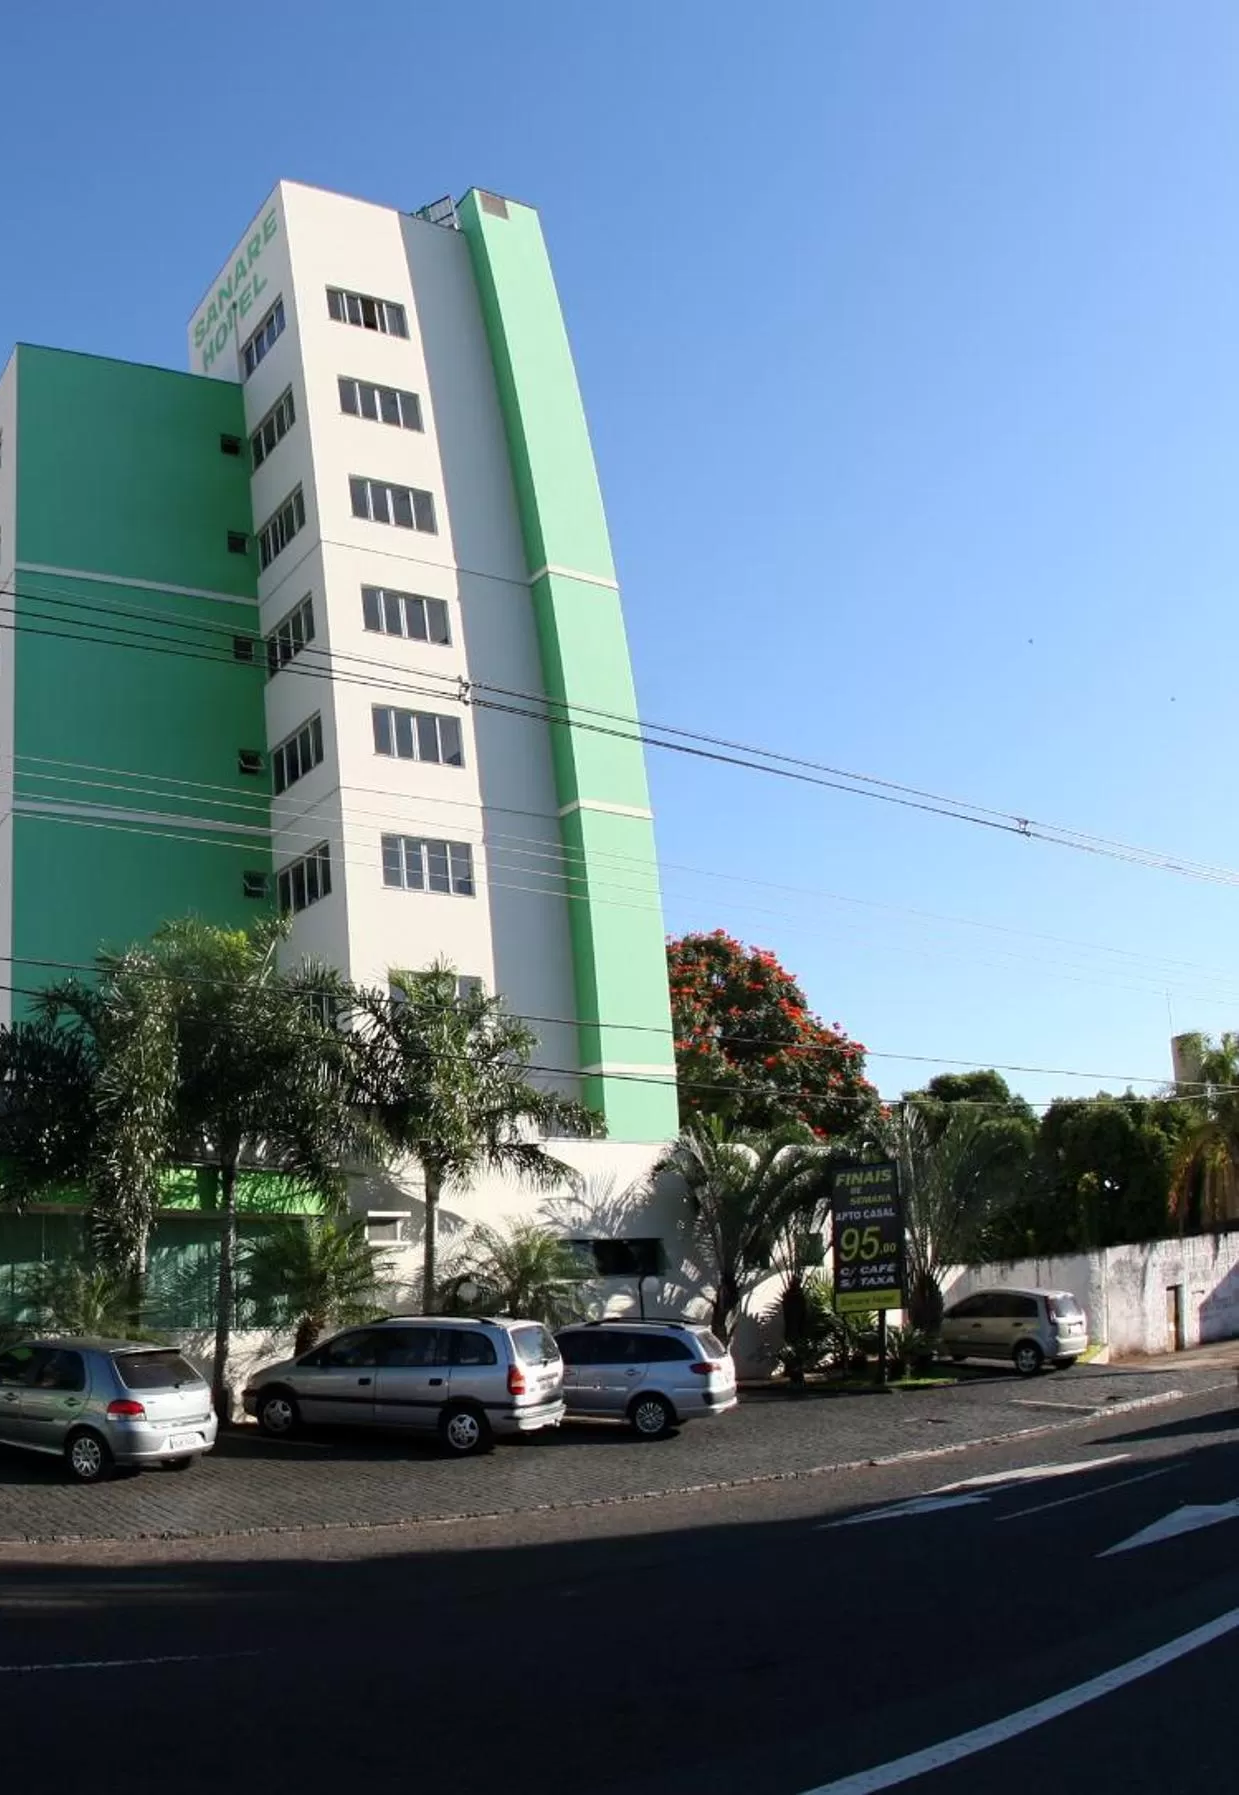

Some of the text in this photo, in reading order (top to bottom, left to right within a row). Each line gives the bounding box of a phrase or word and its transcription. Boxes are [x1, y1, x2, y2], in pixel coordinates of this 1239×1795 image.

[193, 207, 279, 348] SANARE
[202, 272, 268, 372] HOTEL
[835, 1169, 892, 1187] FINAIS
[863, 1207, 896, 1220] CASAL
